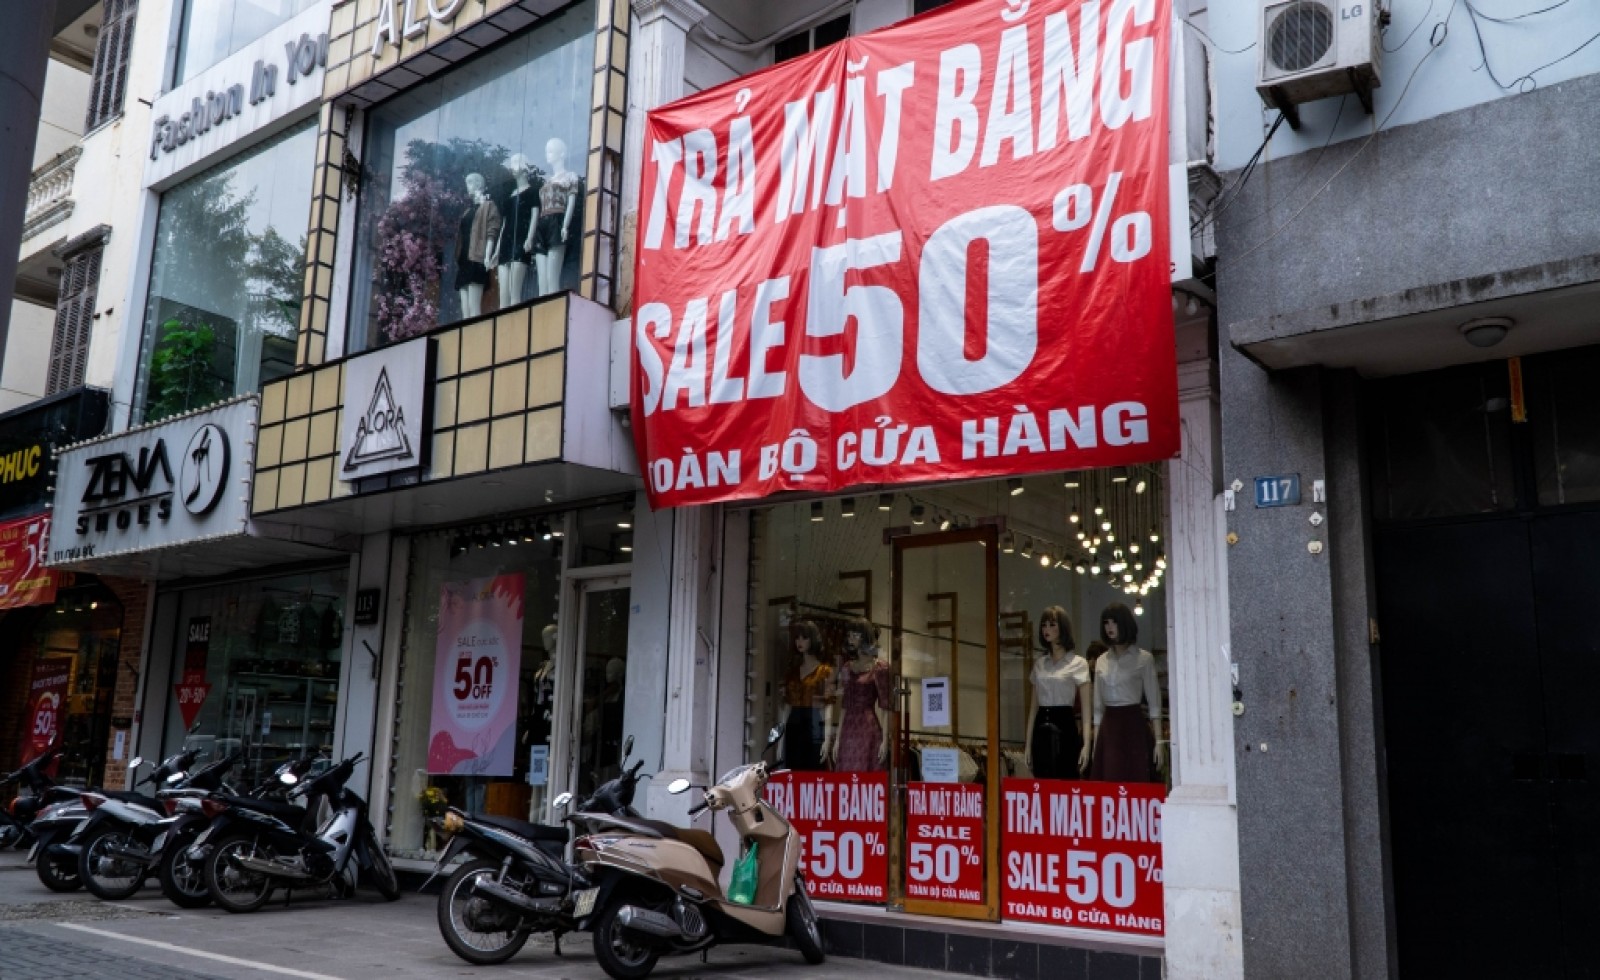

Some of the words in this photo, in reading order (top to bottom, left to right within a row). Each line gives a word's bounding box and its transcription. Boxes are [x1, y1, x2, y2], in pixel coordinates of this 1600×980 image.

[1342, 5, 1361, 20] LG
[150, 83, 244, 160] Fashion
[250, 59, 278, 106] In
[644, 88, 757, 250] TRẢ
[775, 56, 915, 228] MẶT
[636, 275, 790, 417] SALE
[356, 405, 405, 437] ALORA
[759, 428, 818, 482] BỘ
[837, 416, 942, 471] CỬA
[961, 401, 1150, 460] HÀNG
[83, 438, 174, 501] ZENA
[1261, 479, 1292, 503] 117
[76, 499, 172, 534] SHOES
[189, 623, 210, 642] SALE
[457, 636, 476, 648] SALE
[472, 685, 493, 700] OFF
[800, 777, 834, 827] MẶT
[838, 774, 885, 822] BẰNG
[909, 784, 927, 816] TRẢ
[929, 787, 951, 821] MẶT
[1005, 783, 1044, 835] TRẢ
[1050, 787, 1095, 846] MẶT
[1101, 786, 1162, 843] BẰNG
[917, 824, 971, 840] SALE
[810, 831, 885, 878] 50%
[909, 842, 980, 884] 50%
[819, 879, 844, 894] CỬA
[847, 883, 883, 897] HÀNG
[1007, 850, 1060, 893] SALE
[1065, 848, 1163, 908] 50%
[1007, 902, 1047, 918] TOÀN
[1052, 907, 1073, 923] BỘ
[1078, 907, 1110, 924] CỬA
[1115, 913, 1162, 931] HÀNG
